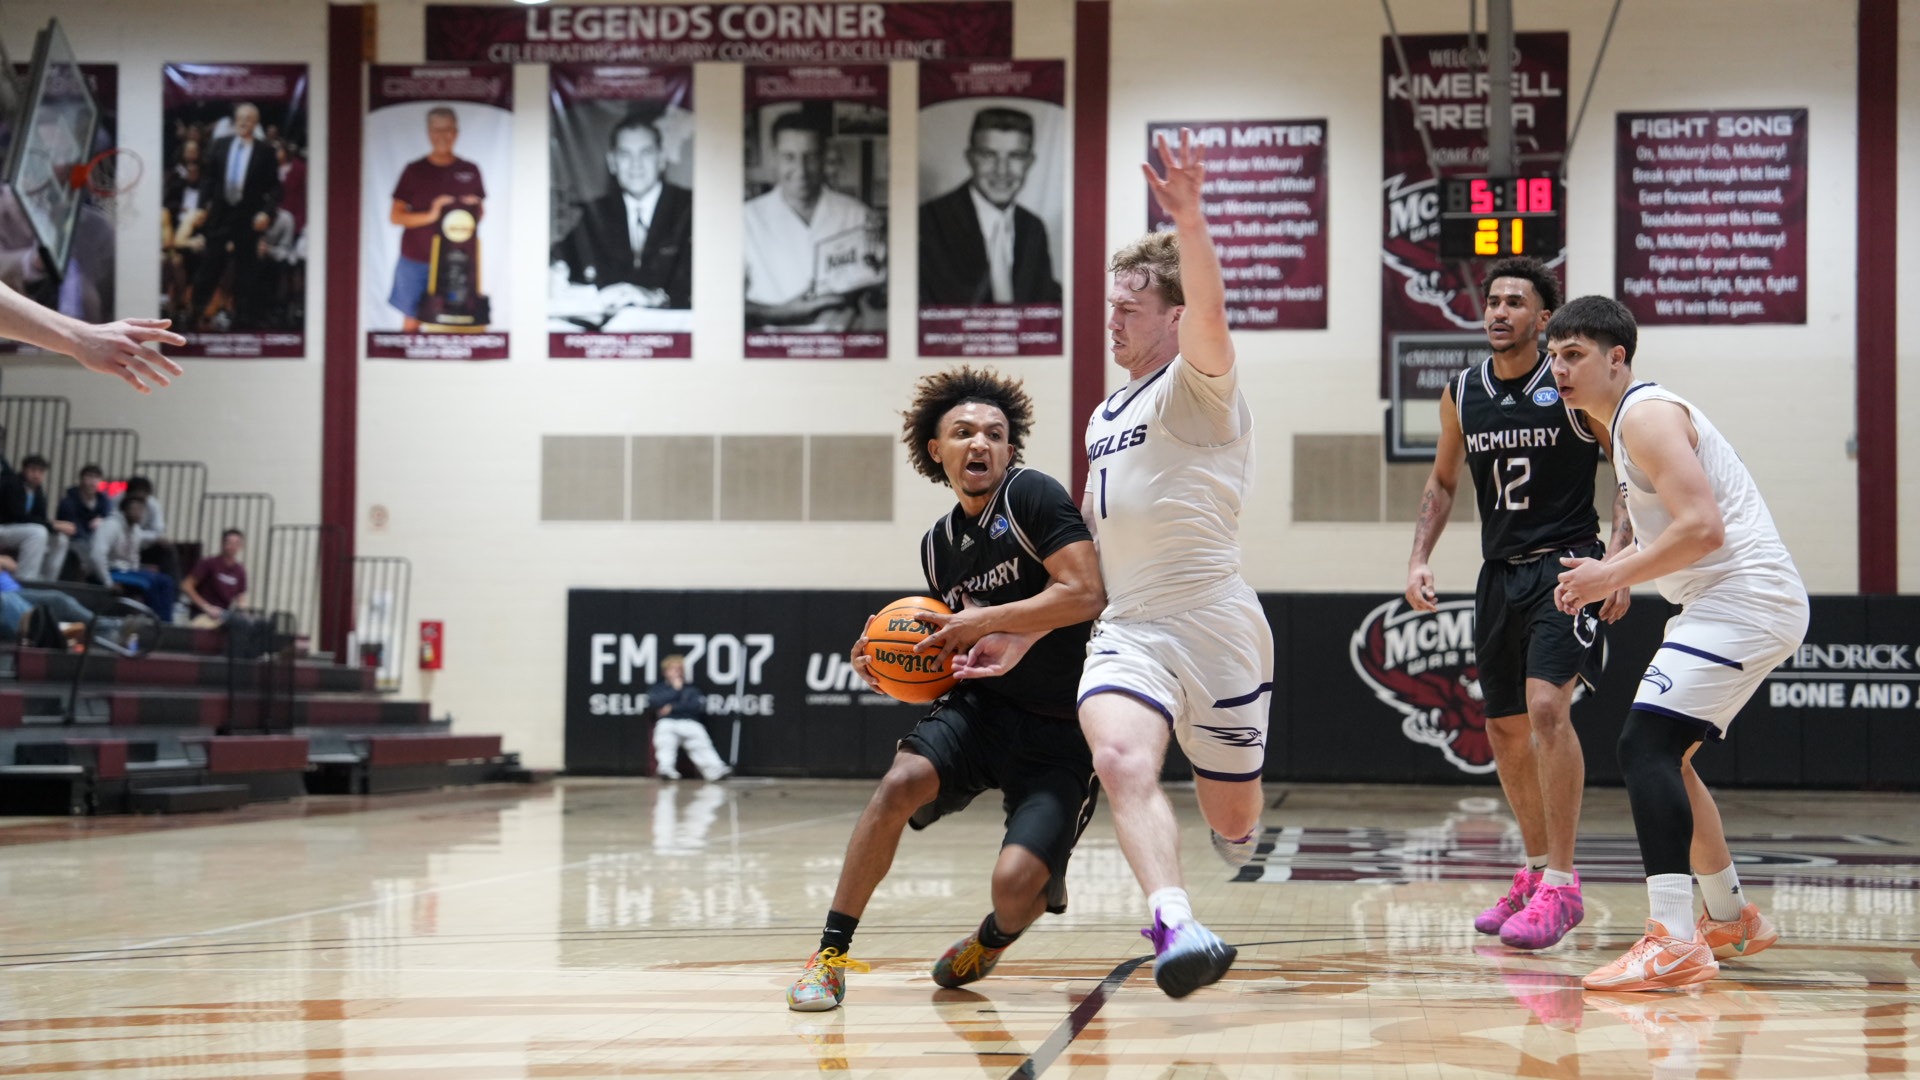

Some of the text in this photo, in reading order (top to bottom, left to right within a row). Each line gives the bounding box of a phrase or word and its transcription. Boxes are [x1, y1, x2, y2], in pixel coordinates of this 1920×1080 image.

[526, 4, 886, 41] LEGENDS CORNER
[488, 42, 619, 63] CELEBRATING
[718, 41, 823, 61] COACHING
[825, 39, 945, 60] EXCELLENCE
[1231, 125, 1322, 147] MATER
[1631, 115, 1793, 139] FIGHT SONG
[1636, 142, 1788, 163] On, McMurry! On, McMurry!
[1632, 164, 1791, 186] Break right through that line!
[1639, 186, 1784, 207] Ever forward, ever onward,
[1640, 211, 1782, 228] Touchdown sure this time.
[1474, 218, 1523, 255] 21
[1635, 231, 1787, 251] On, McMurry! On, McMurry!
[1649, 255, 1678, 274] Fight
[1695, 254, 1712, 270] for
[1713, 256, 1739, 273] your
[1624, 277, 1656, 296] Fight,
[1657, 276, 1700, 294] fellows!
[1701, 276, 1733, 296] Fight,
[1655, 299, 1765, 318] We'll win this game.
[1404, 349, 1466, 367] cMURRY
[1088, 424, 1148, 464] AGLES
[1466, 427, 1560, 453] MCMURRY
[1099, 467, 1108, 519] 1
[1493, 457, 1531, 510] 12
[888, 618, 940, 635] NCAA
[590, 633, 658, 685] FM
[673, 633, 774, 685] 707
[875, 647, 944, 673] Wilson
[1779, 643, 1913, 670] HENDRICK
[589, 693, 775, 716] SELF RAGE
[1769, 682, 1846, 708] BONE
[1850, 683, 1911, 709] AND
